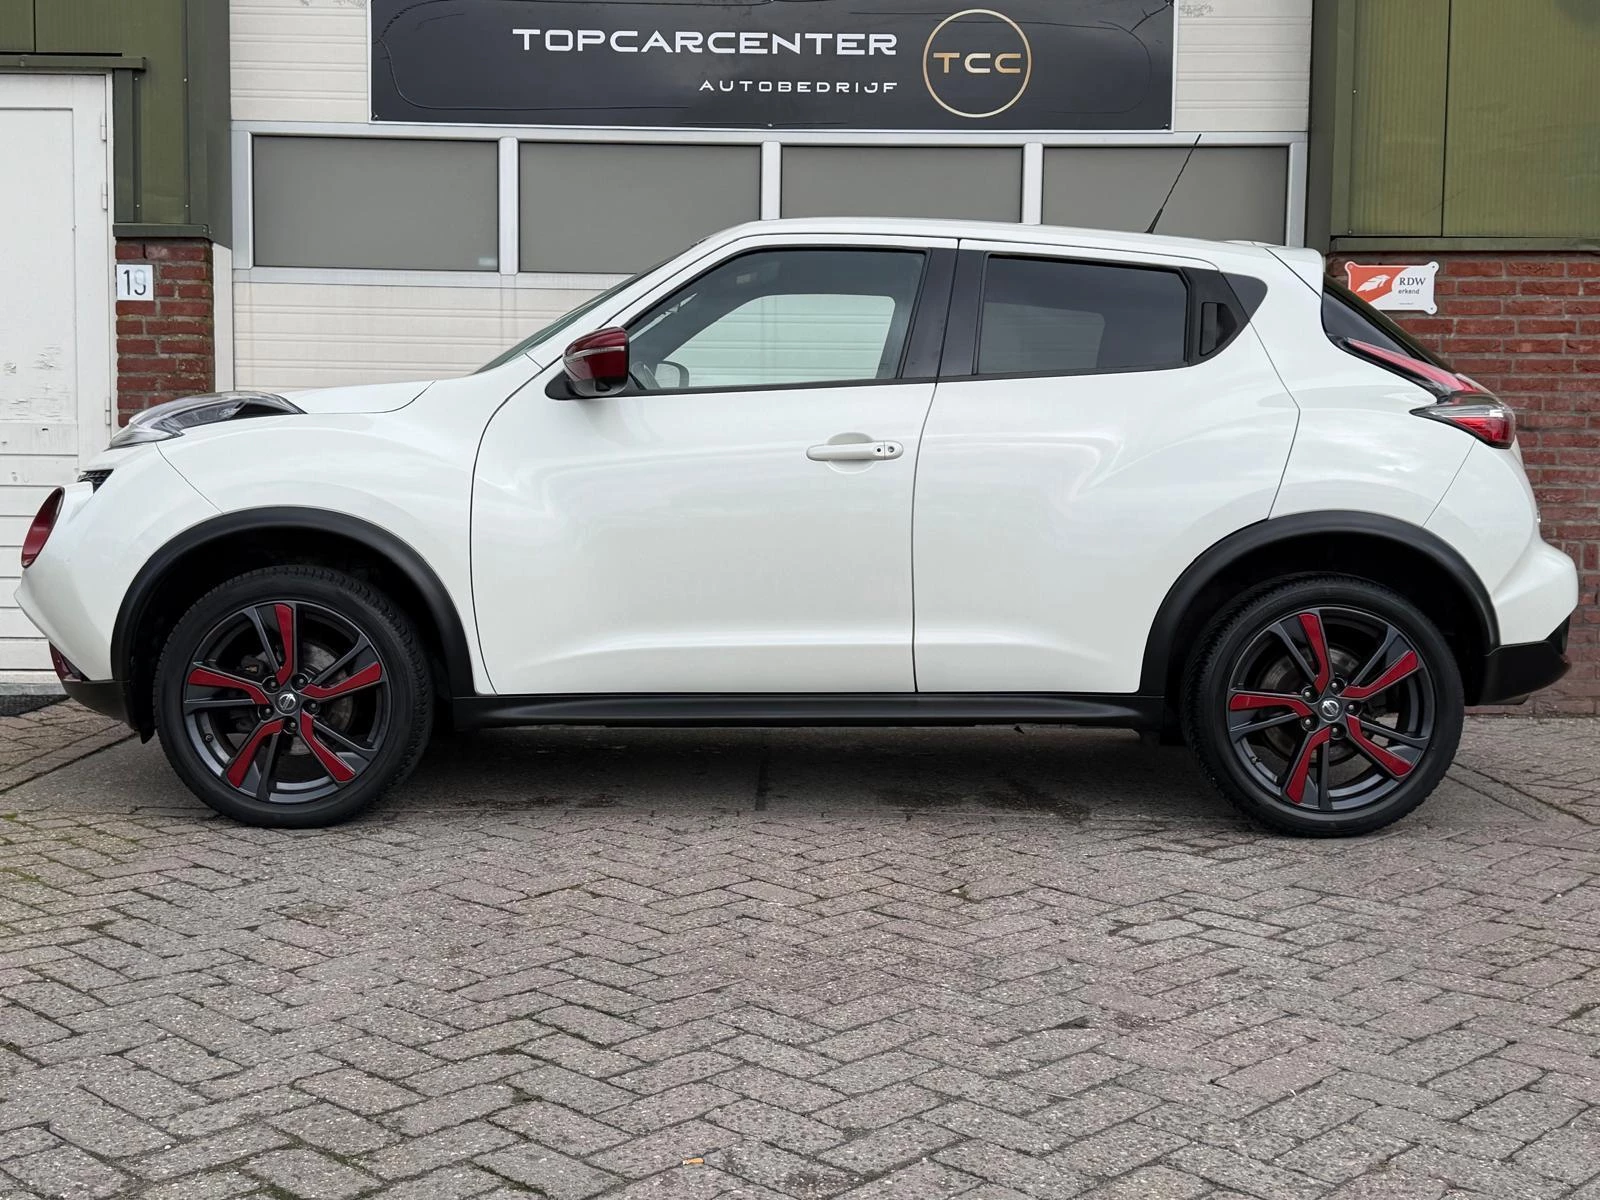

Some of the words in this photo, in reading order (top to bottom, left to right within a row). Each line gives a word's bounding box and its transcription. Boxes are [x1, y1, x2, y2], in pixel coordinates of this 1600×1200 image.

[512, 28, 898, 56] TOPCARCENTER
[933, 52, 1022, 74] TCC
[698, 79, 898, 94] AUTOBEDRIJF
[123, 269, 147, 296] 19
[1399, 277, 1426, 286] RDW
